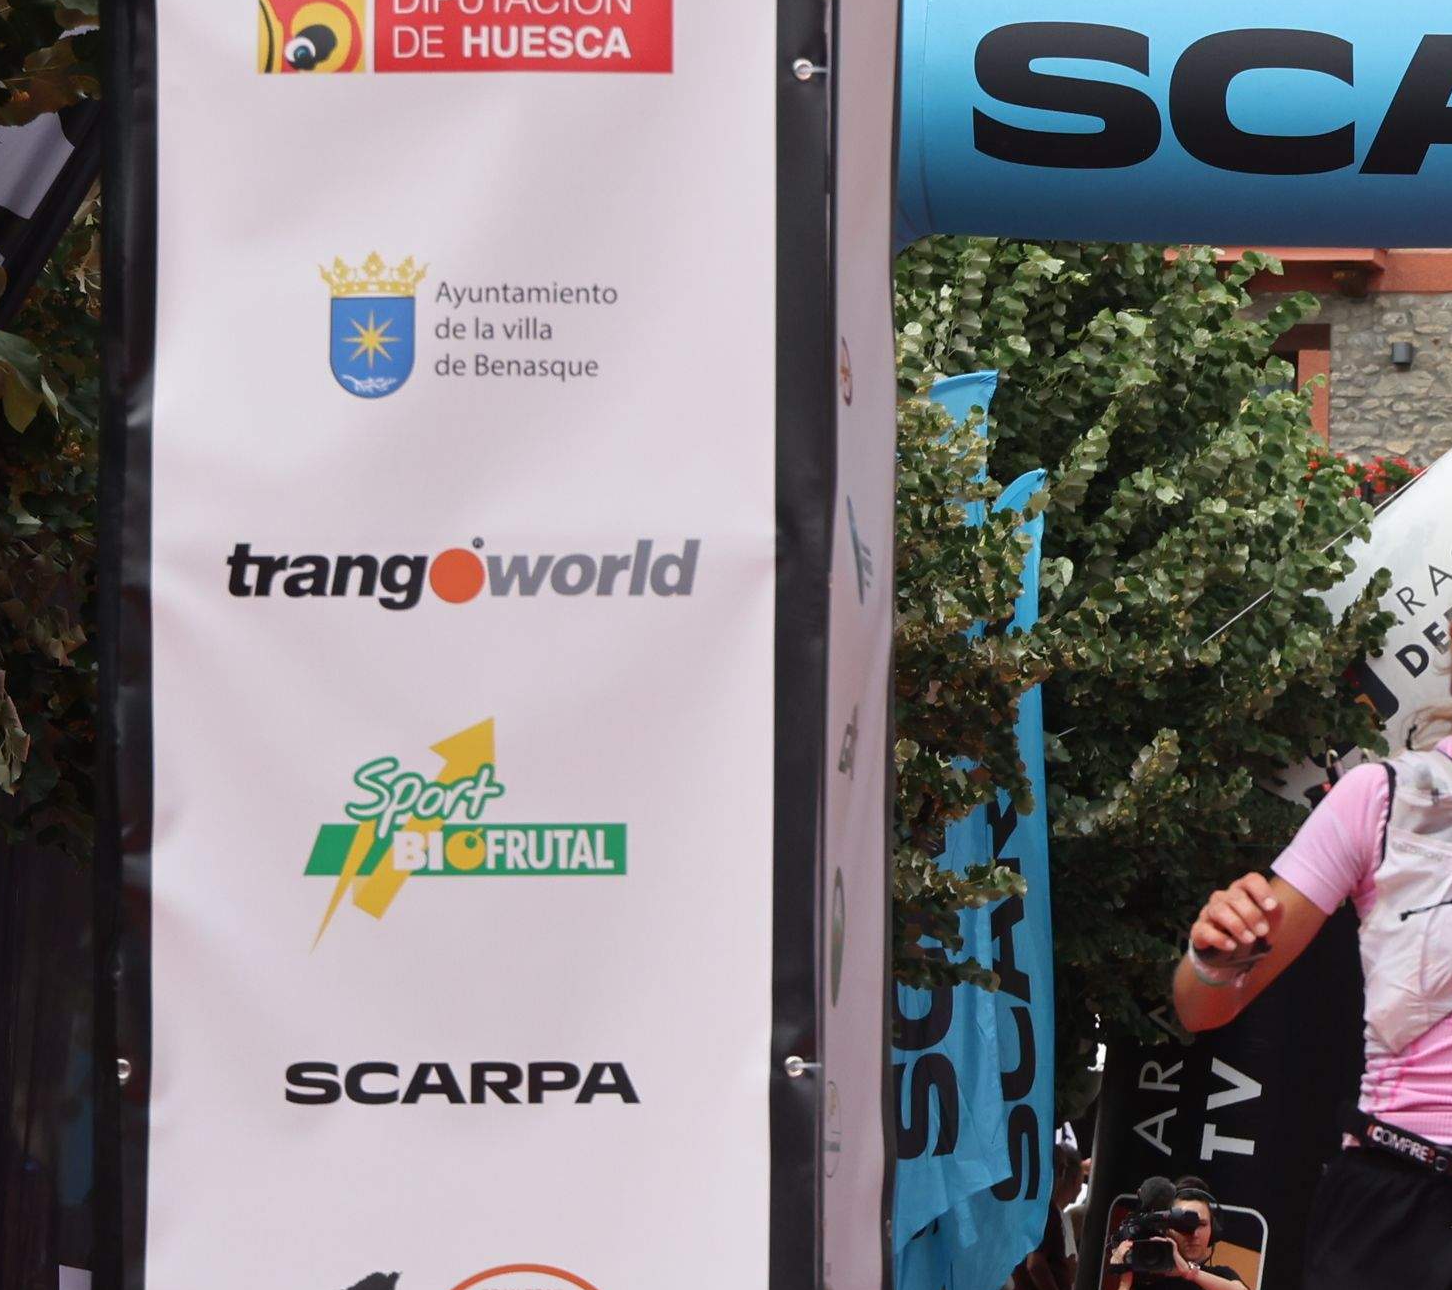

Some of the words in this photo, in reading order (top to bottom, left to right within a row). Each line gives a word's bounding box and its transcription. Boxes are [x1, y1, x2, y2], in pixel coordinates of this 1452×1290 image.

[393, 26, 445, 59] DE
[462, 25, 631, 59] HUESCA
[435, 280, 618, 308] Ayuntamiento
[435, 317, 466, 340] de
[473, 317, 495, 340] la
[501, 317, 553, 340] villa
[435, 354, 466, 377] de
[473, 355, 599, 382] Benasque
[344, 756, 504, 838] Sport
[392, 826, 614, 871] BIOFRUTAL
[285, 1061, 640, 1105] SCARPA
[1199, 1056, 1263, 1161] TV
